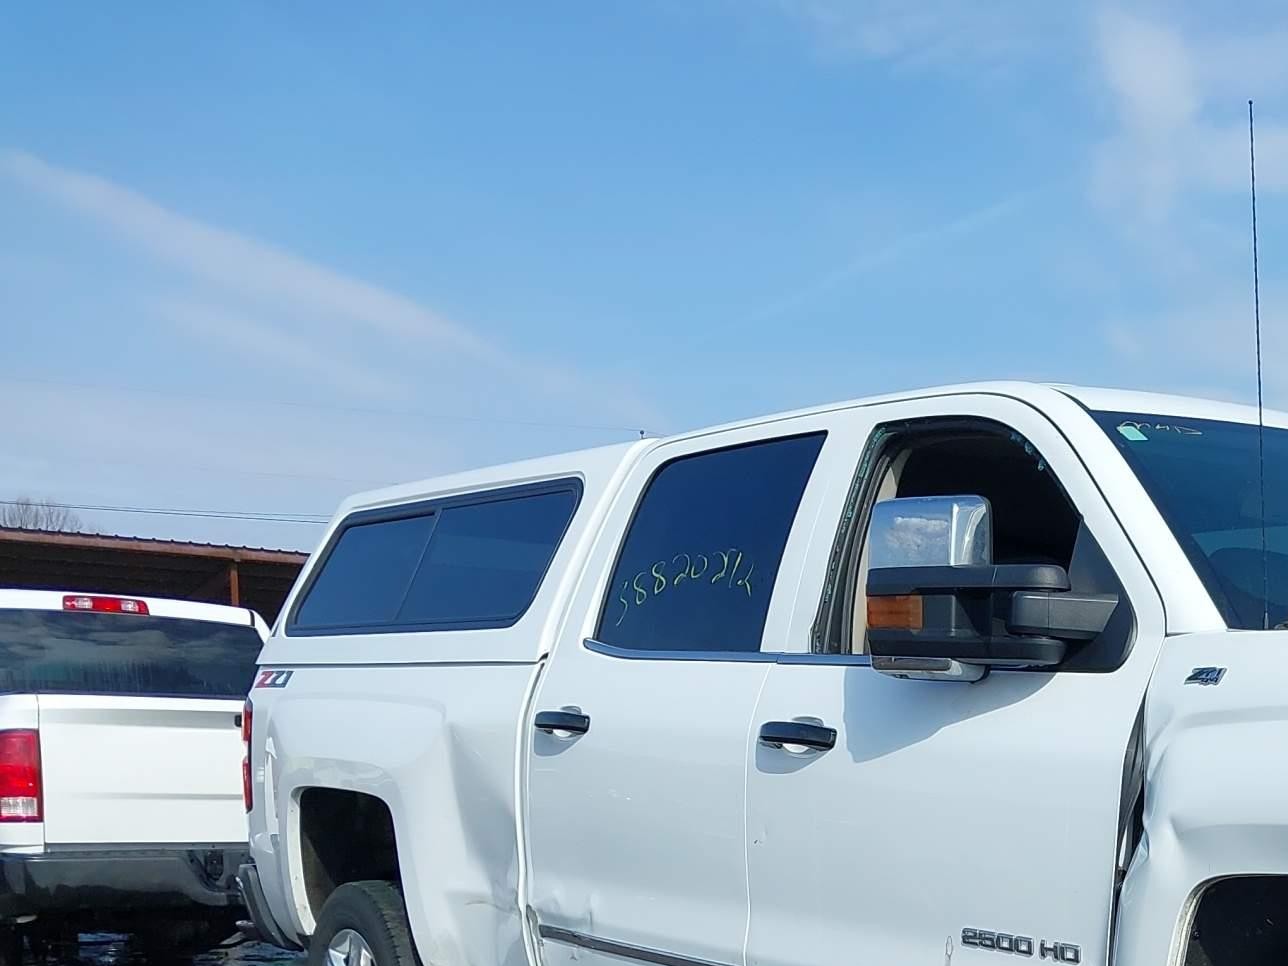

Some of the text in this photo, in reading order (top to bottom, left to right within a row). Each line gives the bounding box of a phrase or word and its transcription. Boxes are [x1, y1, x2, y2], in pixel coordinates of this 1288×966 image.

[255, 670, 295, 688] Z71
[961, 927, 1081, 965] 2500 HD
